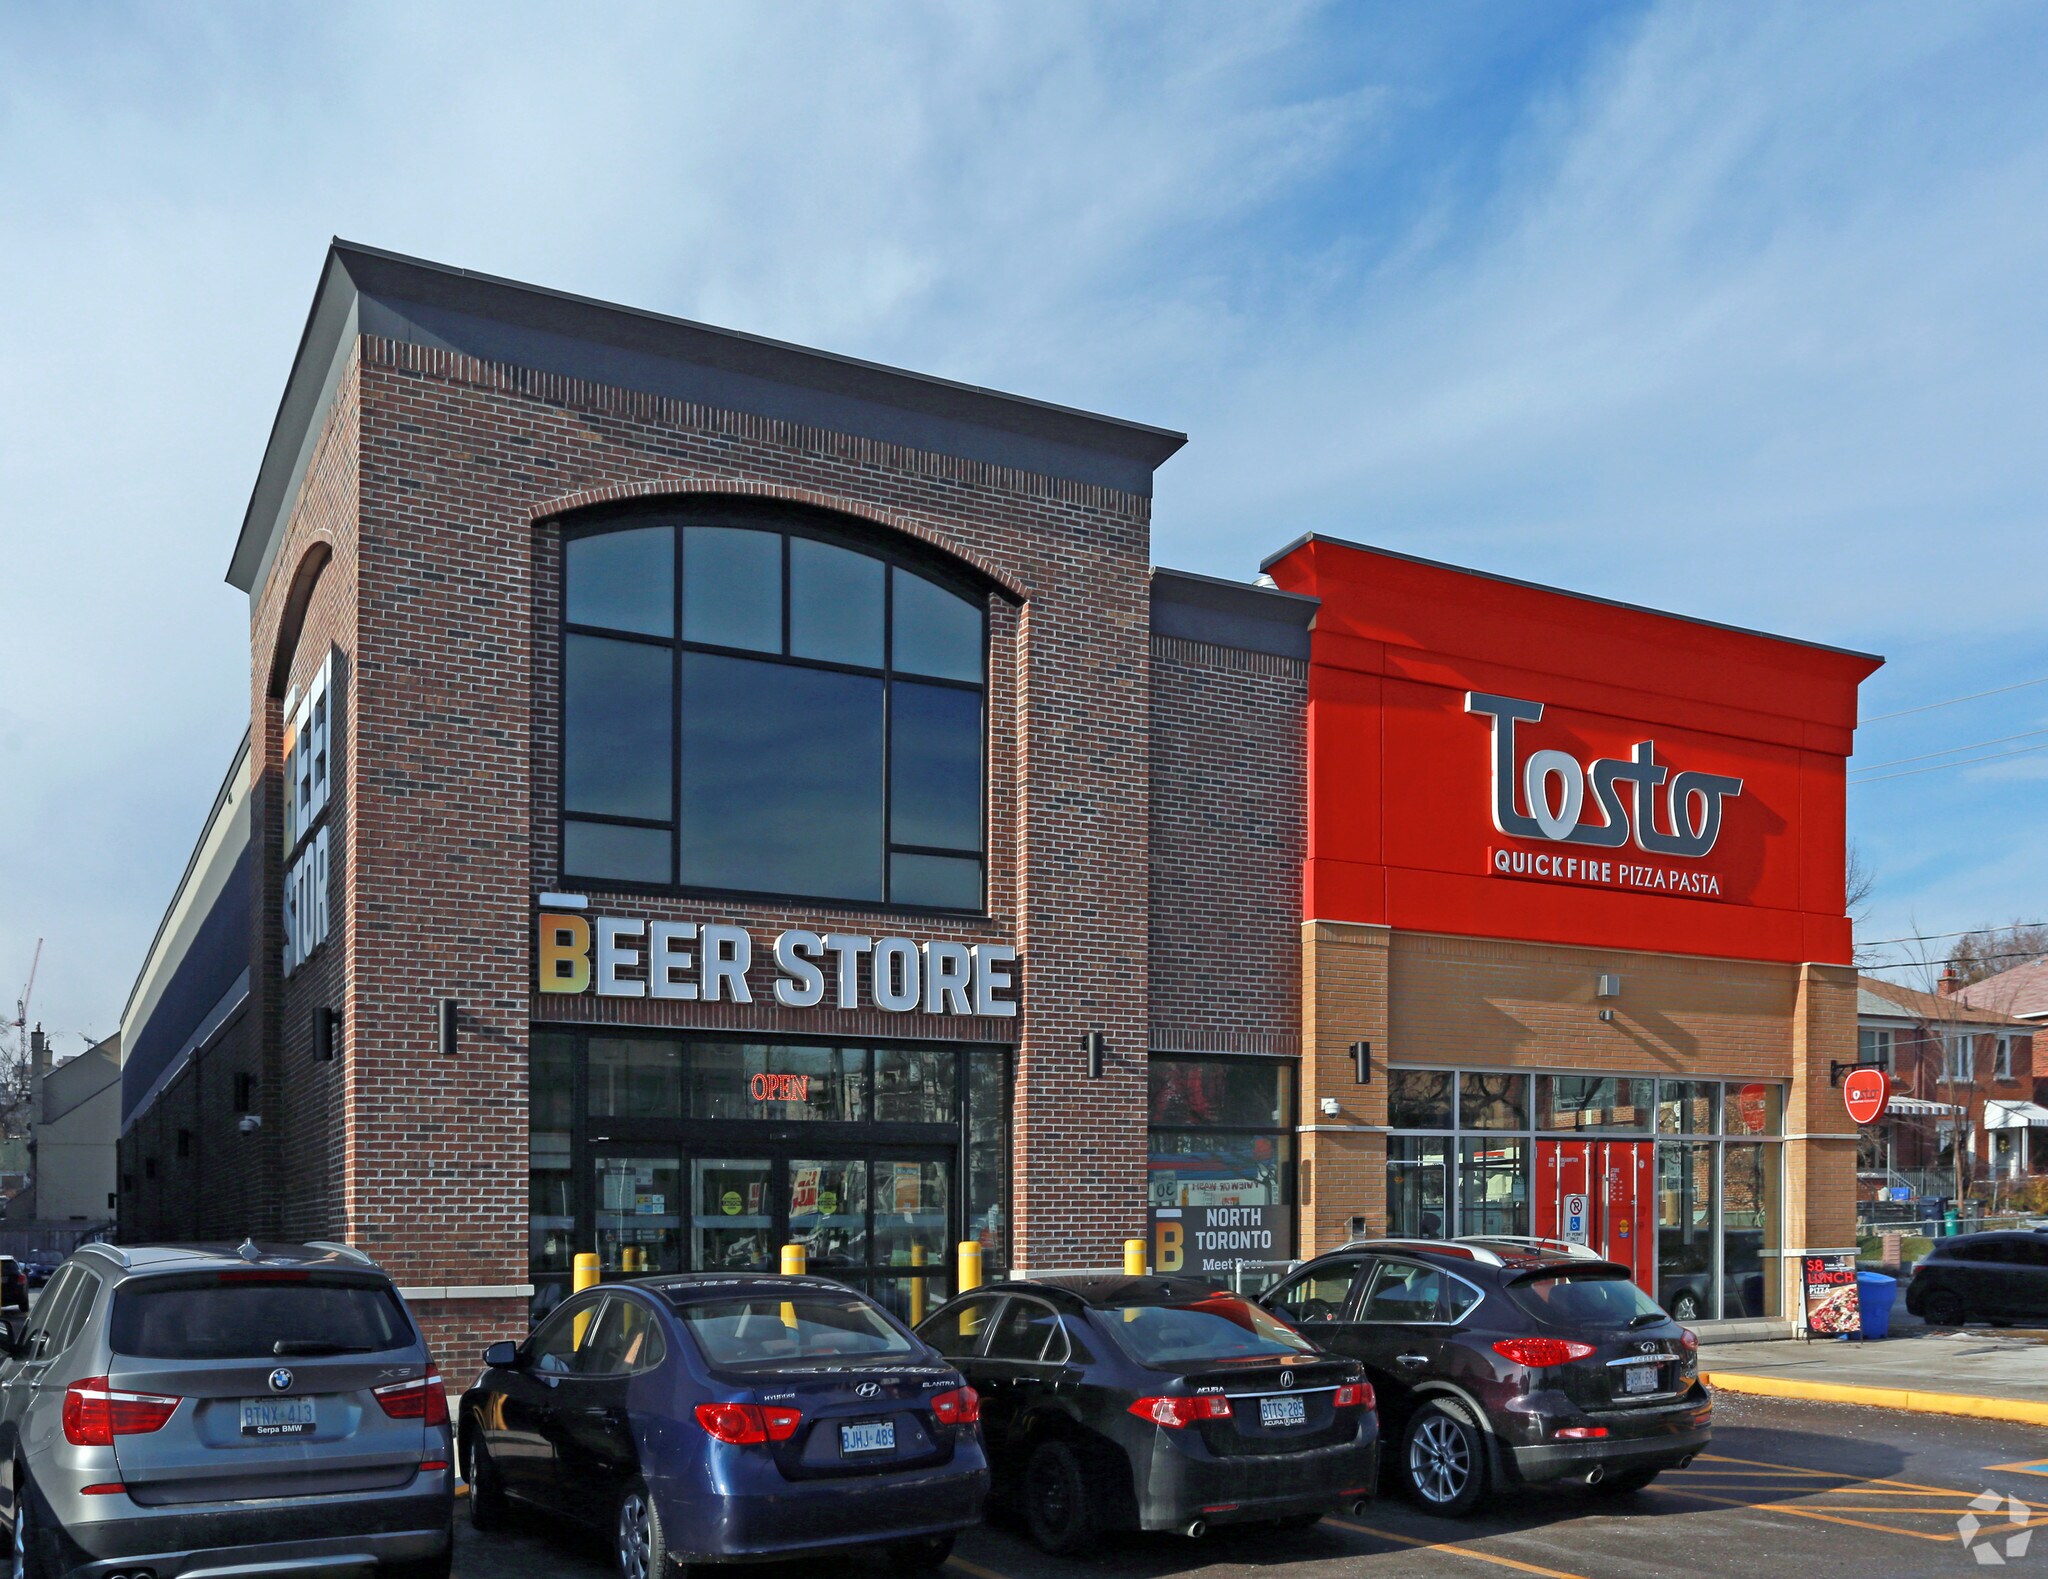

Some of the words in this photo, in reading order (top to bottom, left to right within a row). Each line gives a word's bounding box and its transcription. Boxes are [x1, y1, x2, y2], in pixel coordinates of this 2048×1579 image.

[1464, 690, 1743, 858] Tosto
[1494, 848, 1611, 883] QUICKFIRE
[1619, 863, 1667, 889] PIZZA
[1670, 870, 1720, 895] PASTA
[539, 912, 753, 1004] BEER
[772, 928, 1017, 1018] STORE
[750, 1073, 809, 1101] OPEN
[1206, 1208, 1262, 1227] NORTH
[1156, 1221, 1184, 1272] B
[1195, 1230, 1272, 1250] TORONTO
[1202, 1258, 1233, 1271] Meet
[1806, 1257, 1824, 1273] $8
[1807, 1271, 1854, 1285] LUNCH
[922, 1380, 955, 1388] ELANTRA
[1197, 1386, 1225, 1394] ACURA
[257, 1425, 280, 1435] Serpa
[282, 1424, 302, 1433] BMW
